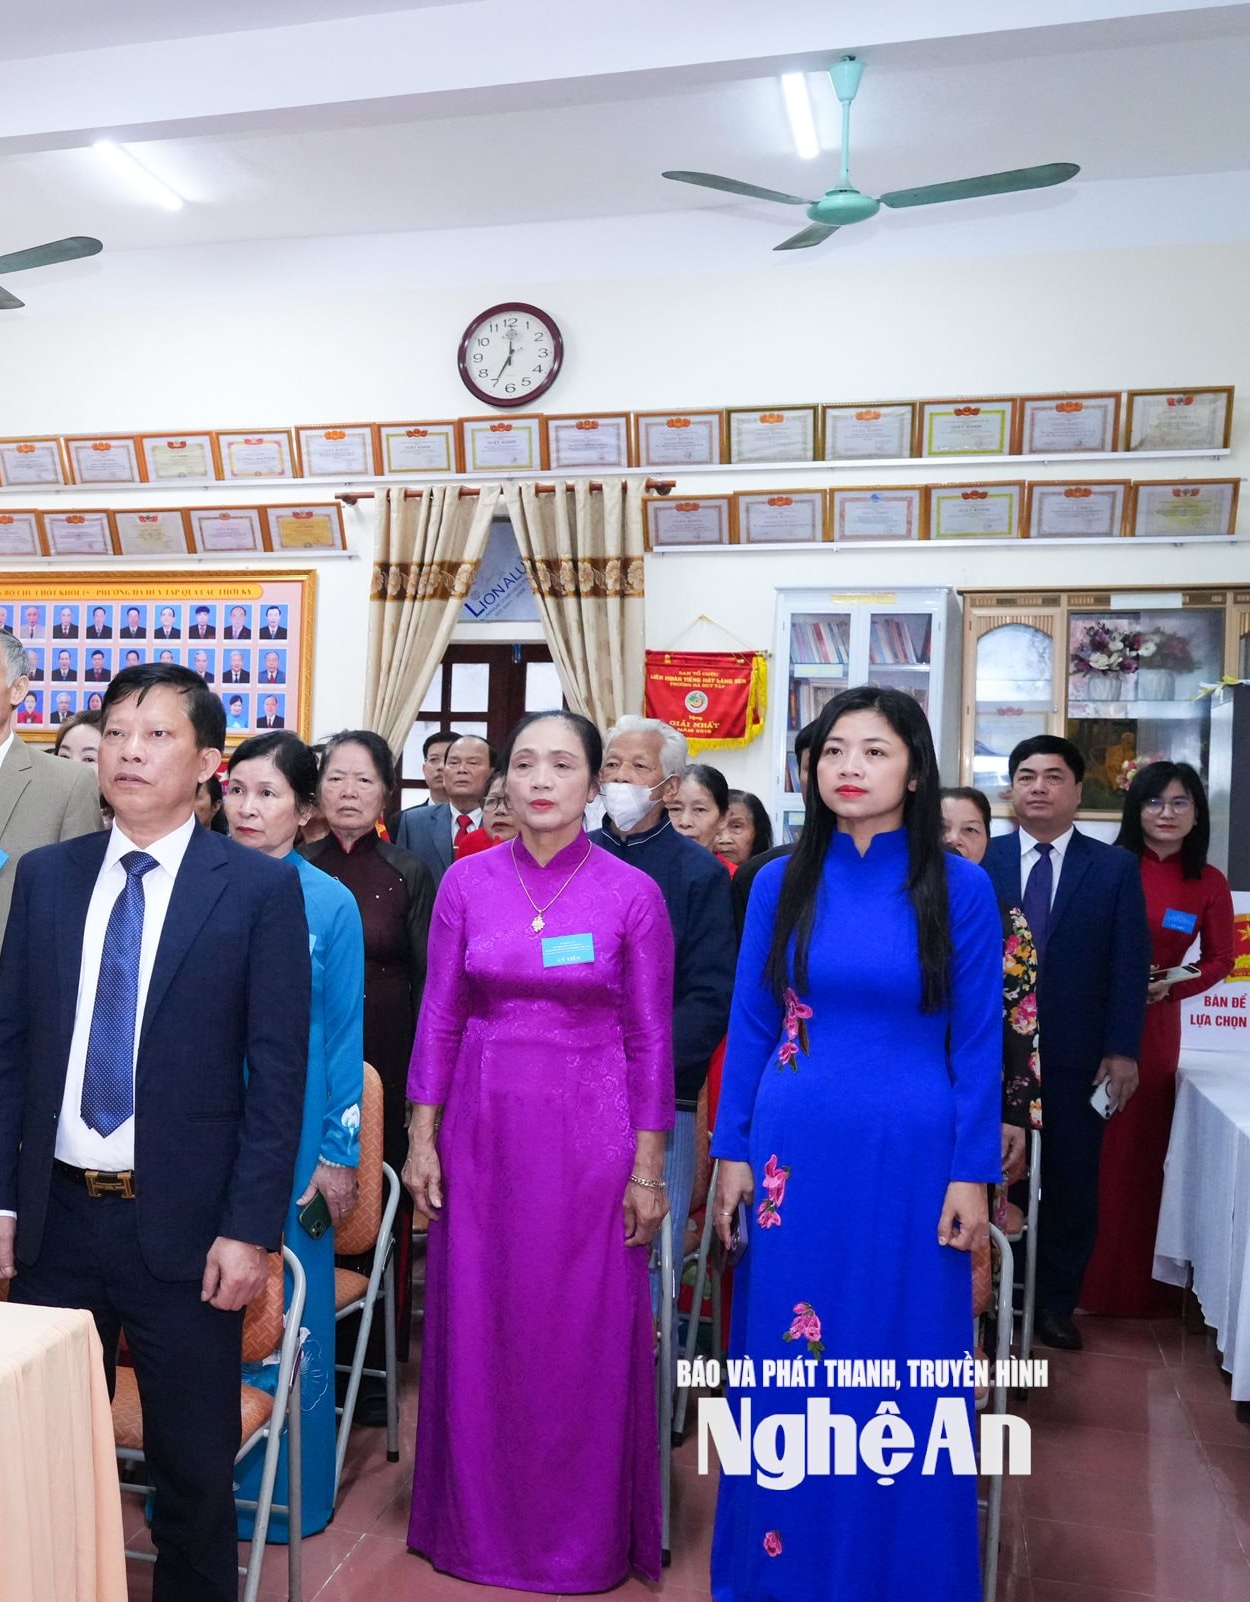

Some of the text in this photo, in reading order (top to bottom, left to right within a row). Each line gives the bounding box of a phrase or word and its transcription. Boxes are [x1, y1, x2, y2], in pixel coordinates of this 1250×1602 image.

[490, 323, 498, 333] 11
[503, 318, 518, 328] 12
[477, 337, 490, 347] 10
[534, 332, 544, 342] 2
[473, 353, 484, 363] 9
[538, 348, 548, 358] 3
[478, 368, 489, 378] 8
[532, 364, 542, 374] 4
[491, 378, 499, 388] 7
[522, 376, 532, 386] 5
[504, 383, 516, 393] 6
[694, 720, 720, 728] NHẤT
[1204, 994, 1228, 1008] BÀN
[1190, 1014, 1247, 1030] LỰA CHỌN
